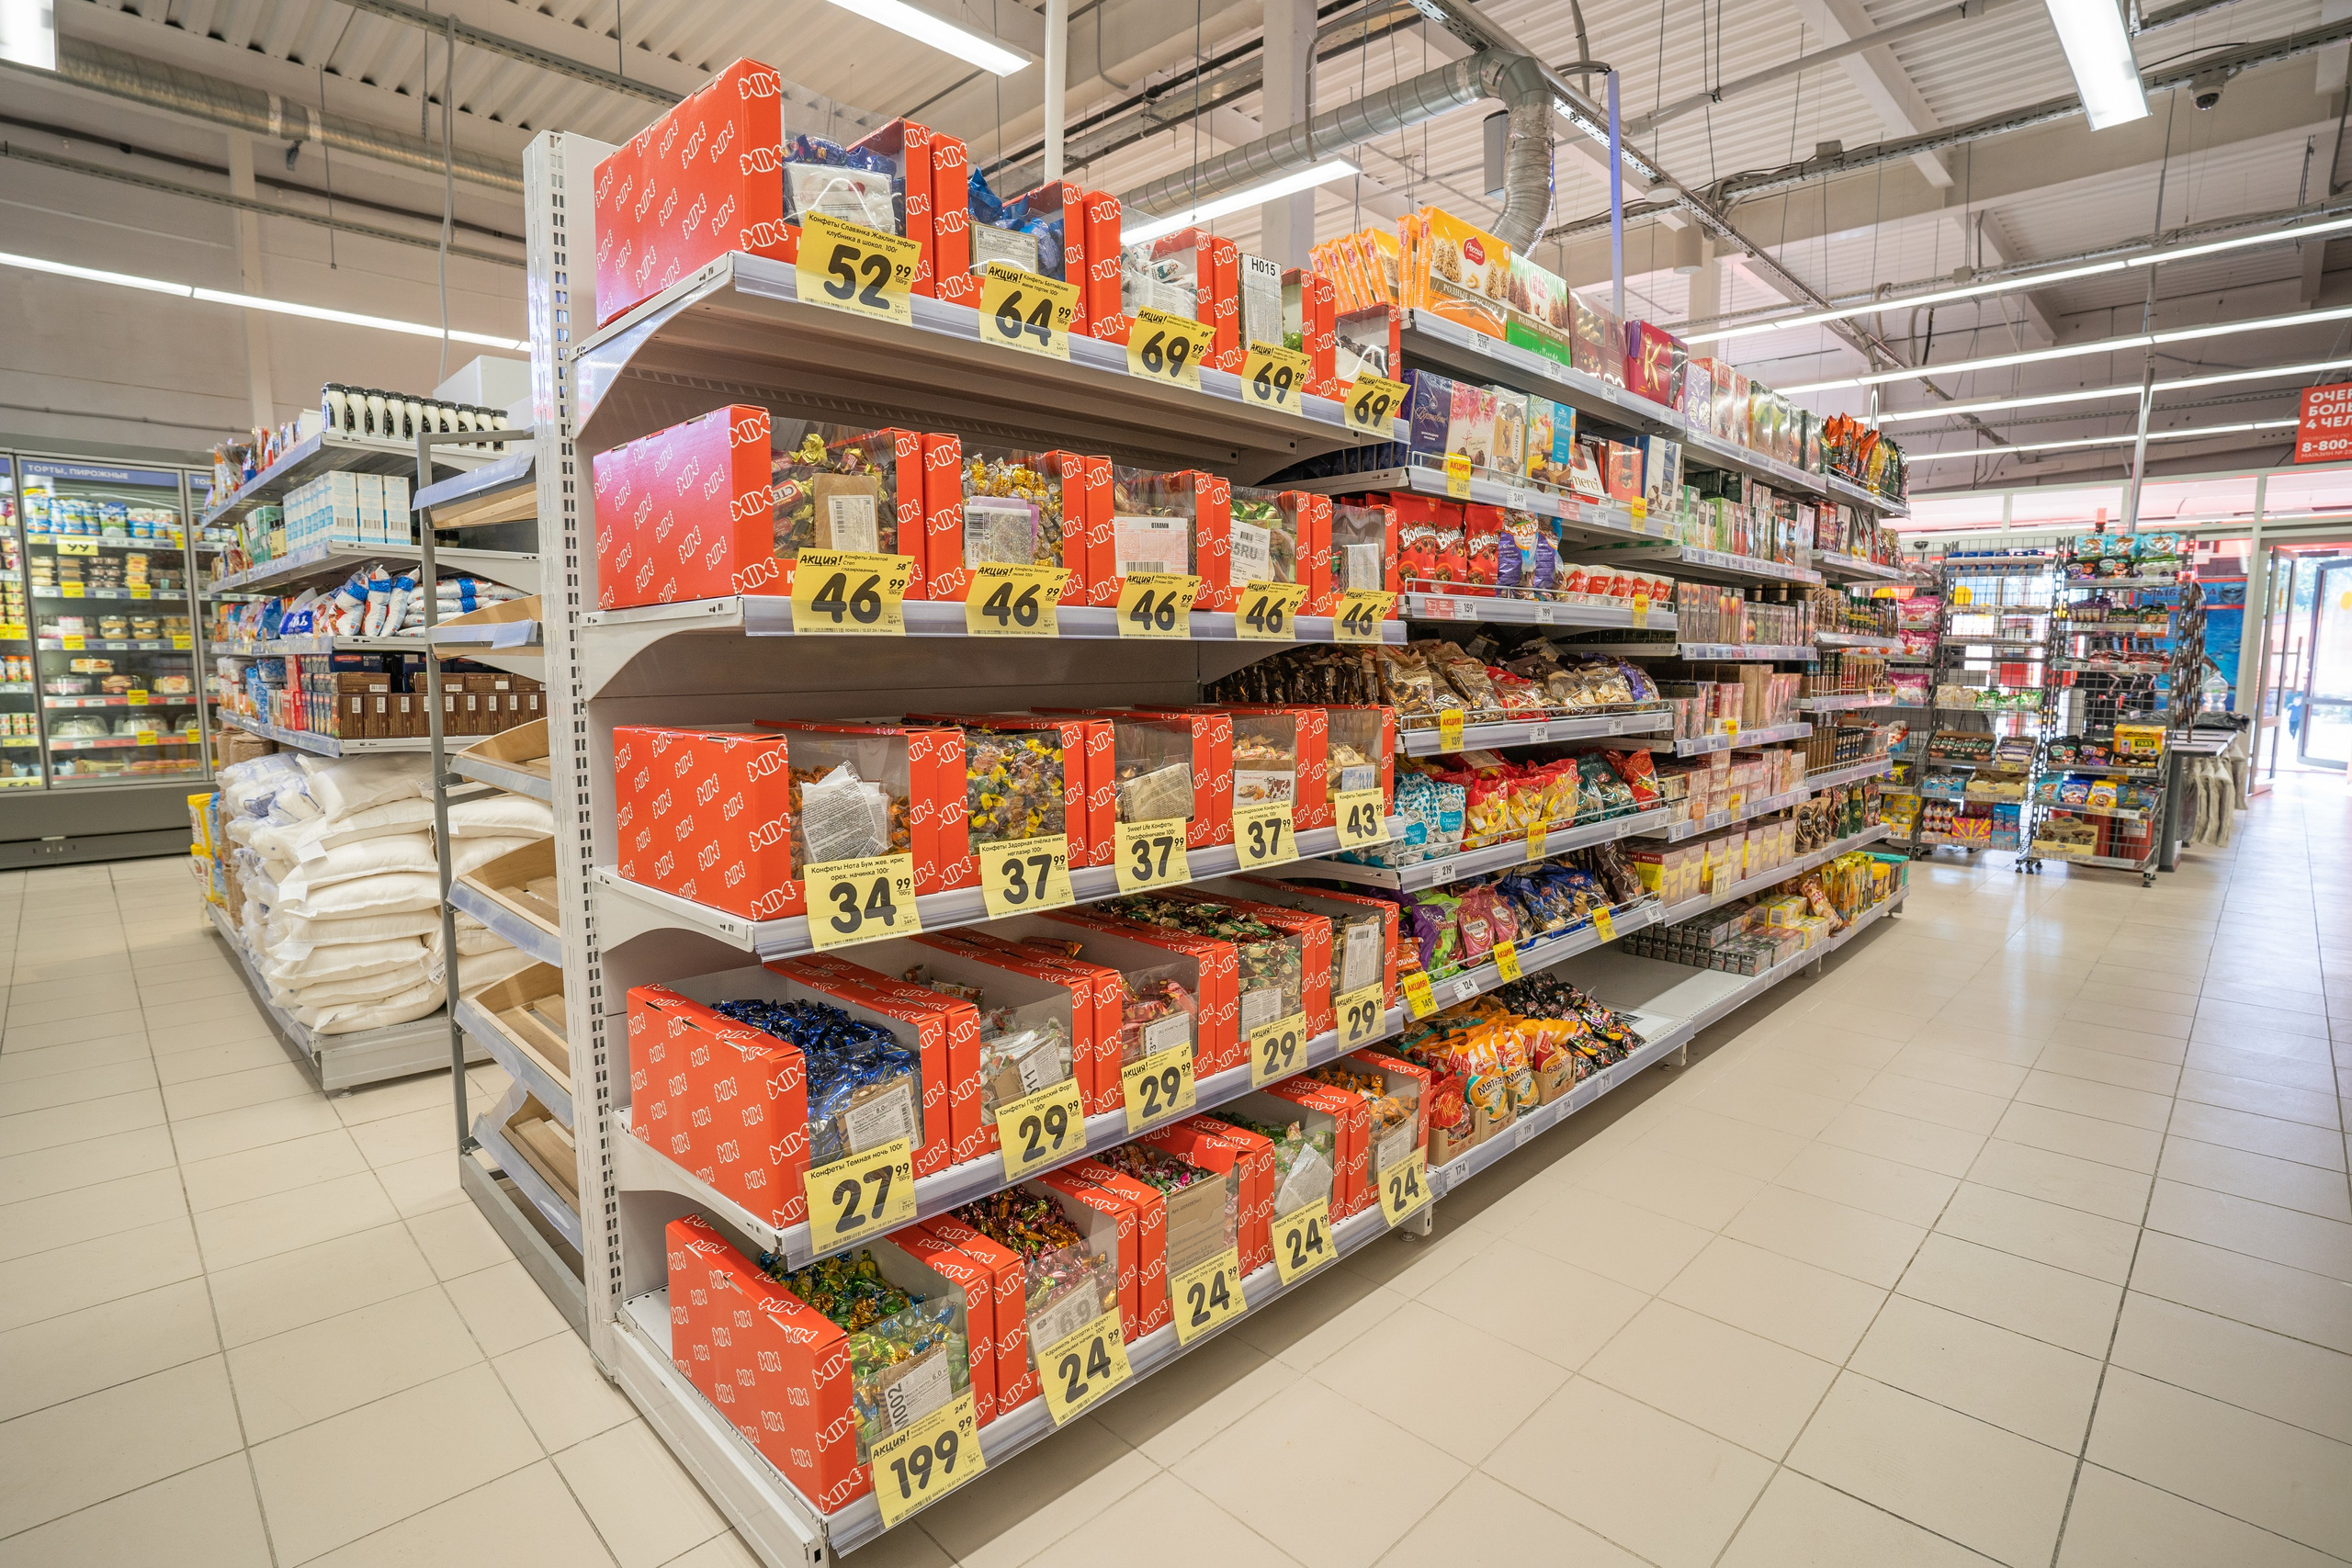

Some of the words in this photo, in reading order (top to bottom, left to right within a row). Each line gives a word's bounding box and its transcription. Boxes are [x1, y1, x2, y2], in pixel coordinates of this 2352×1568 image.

[808, 213, 840, 229] Конфеты
[841, 223, 871, 236] Славянка
[871, 231, 896, 244] Жаклин
[897, 239, 916, 250] зефир
[826, 230, 856, 243] клубника
[862, 240, 883, 250] шокол.
[886, 245, 899, 254] 100г
[1464, 242, 1484, 259] Россия
[823, 243, 892, 310] 52
[895, 264, 911, 277] 99
[895, 277, 908, 286] 100гр
[988, 266, 1023, 284] АКЦИЯ!
[1023, 275, 1045, 285] Конфеты
[1442, 283, 1472, 300] РОДНЫЕ
[1472, 296, 1499, 314] ПРОСТОРЫ
[995, 290, 1053, 347] 64
[1058, 307, 1071, 319] 99
[1137, 310, 1167, 325] АКЦИЯ!
[1517, 315, 1538, 330] РОДНЫЕ
[1538, 323, 1564, 342] ПРОСТОРЫ
[1250, 343, 1274, 356] АКЦИЯ!
[1477, 339, 1487, 349] 219
[1141, 330, 1191, 378] 69
[1193, 344, 1204, 354] 99
[1252, 362, 1294, 404] 69
[1295, 372, 1305, 381] 99
[1353, 389, 1391, 428] 69
[1391, 400, 1400, 408] 99
[2305, 418, 2317, 430] 4
[2301, 438, 2352, 453] 8-800-
[28, 464, 67, 476] ТОРТЫ,
[69, 468, 129, 480] ПИРОЖНЫЕ
[1449, 461, 1469, 472] АКЦИЯ!
[1456, 482, 1466, 492] 269
[1572, 476, 1600, 492] merci
[773, 486, 795, 502] СТЕ
[1513, 493, 1523, 503] 249
[799, 555, 842, 567] АКЦИЯ!
[978, 567, 1013, 577] АКЦИЯ!
[1126, 575, 1155, 585] АКЦИЯ!
[811, 572, 882, 624] 46
[888, 579, 905, 590] 99
[982, 581, 1041, 627] 46
[1046, 588, 1059, 597] 99
[1130, 590, 1177, 631] 46
[1182, 594, 1193, 604] 99
[1246, 595, 1286, 633] 46
[1464, 603, 1473, 613] 159
[1542, 607, 1551, 616] 199
[1342, 603, 1377, 636] 46
[1442, 716, 1462, 728] АКЦИЯ!
[1451, 736, 1461, 746] 139
[1126, 824, 1141, 832] Sweet
[1347, 803, 1377, 839] 43
[1248, 818, 1282, 859] 37
[1283, 818, 1291, 828] 99
[1529, 828, 1545, 837] АКЦИЯ!
[982, 844, 1007, 852] Конфеты
[1534, 843, 1543, 853] 99
[810, 865, 842, 874] Конфеты
[843, 862, 860, 871] Нота
[890, 857, 905, 865] ирис
[1131, 836, 1173, 881] 37
[1174, 837, 1184, 846] 99
[831, 874, 848, 882] орех.
[1002, 853, 1053, 904] 37
[1053, 855, 1066, 866] 99
[829, 877, 897, 933] 34
[896, 877, 910, 890] 99
[1498, 949, 1513, 959] АКЦИЯ!
[1507, 965, 1516, 975] 94
[1408, 979, 1428, 993] АКЦИЯ!
[1463, 979, 1473, 989] 124
[1422, 998, 1432, 1009] 149
[1349, 1000, 1375, 1041] 29
[1252, 1025, 1272, 1039] АКЦИЯ!
[1263, 1031, 1296, 1076] 29
[1297, 1028, 1305, 1038] 99
[1123, 1061, 1148, 1079] АКЦИЯ!
[1140, 1066, 1181, 1118] 29
[1182, 1062, 1191, 1073] 99
[1000, 1102, 1026, 1116] Конфеты
[1026, 1088, 1058, 1106] Петровский
[1058, 1083, 1073, 1093] Форт
[1034, 1104, 1046, 1112] 100г
[1019, 1105, 1069, 1162] 29
[1068, 1100, 1080, 1111] 99
[810, 1164, 845, 1179] Конфеты
[845, 1155, 872, 1168] Темная
[872, 1150, 888, 1159] ночь
[888, 1144, 903, 1153] 100г
[1455, 1165, 1465, 1176] 174
[1389, 1166, 1419, 1212] 24
[832, 1165, 894, 1234] 27
[895, 1162, 910, 1176] 99
[1285, 1217, 1324, 1270] 24
[1320, 1213, 1329, 1224] 99
[1175, 1272, 1194, 1282] Конфеты
[1187, 1269, 1230, 1327] 24
[1227, 1266, 1238, 1277] 99
[1045, 1339, 1070, 1358] Карамель
[1070, 1327, 1091, 1341] Ассорти
[1054, 1342, 1080, 1360] ягодными
[1095, 1325, 1106, 1335] 100г
[1058, 1337, 1112, 1404] 24
[1108, 1328, 1119, 1342] 99
[955, 1402, 968, 1415] 249
[964, 1431, 971, 1439] кг
[873, 1430, 910, 1459] АКЦИЯ!
[890, 1430, 959, 1500] 199
[959, 1416, 973, 1432] 99
